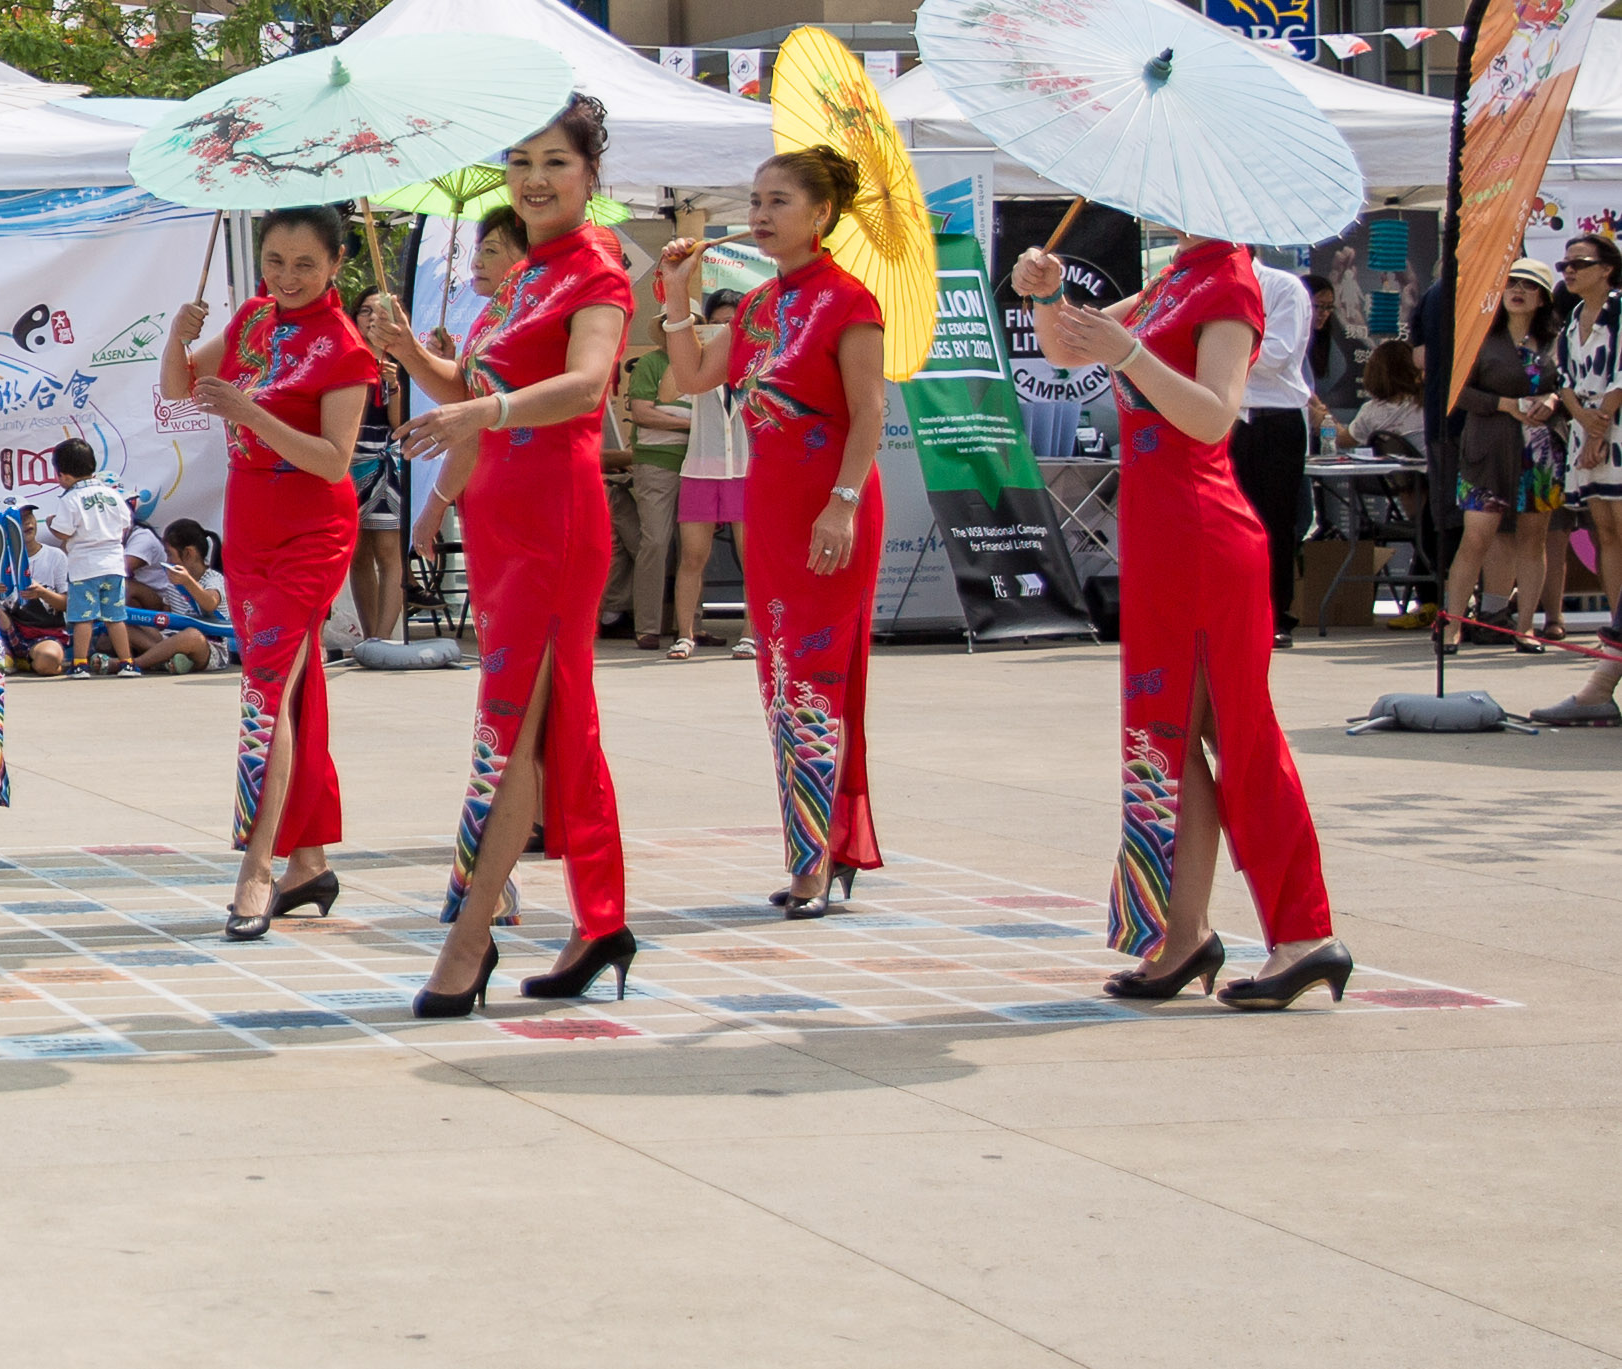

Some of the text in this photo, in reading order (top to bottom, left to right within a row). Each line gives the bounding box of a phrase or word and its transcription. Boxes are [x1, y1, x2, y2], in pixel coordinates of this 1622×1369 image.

[952, 340, 969, 358] BY
[970, 340, 992, 359] 2020
[1013, 364, 1108, 400] CAMPAIGN
[28, 412, 98, 429] Association
[170, 418, 207, 430] WCPC
[950, 527, 967, 538] The
[983, 524, 1016, 537] National
[1017, 523, 1048, 537] Campaign
[969, 539, 1043, 552] for Financial Literacy
